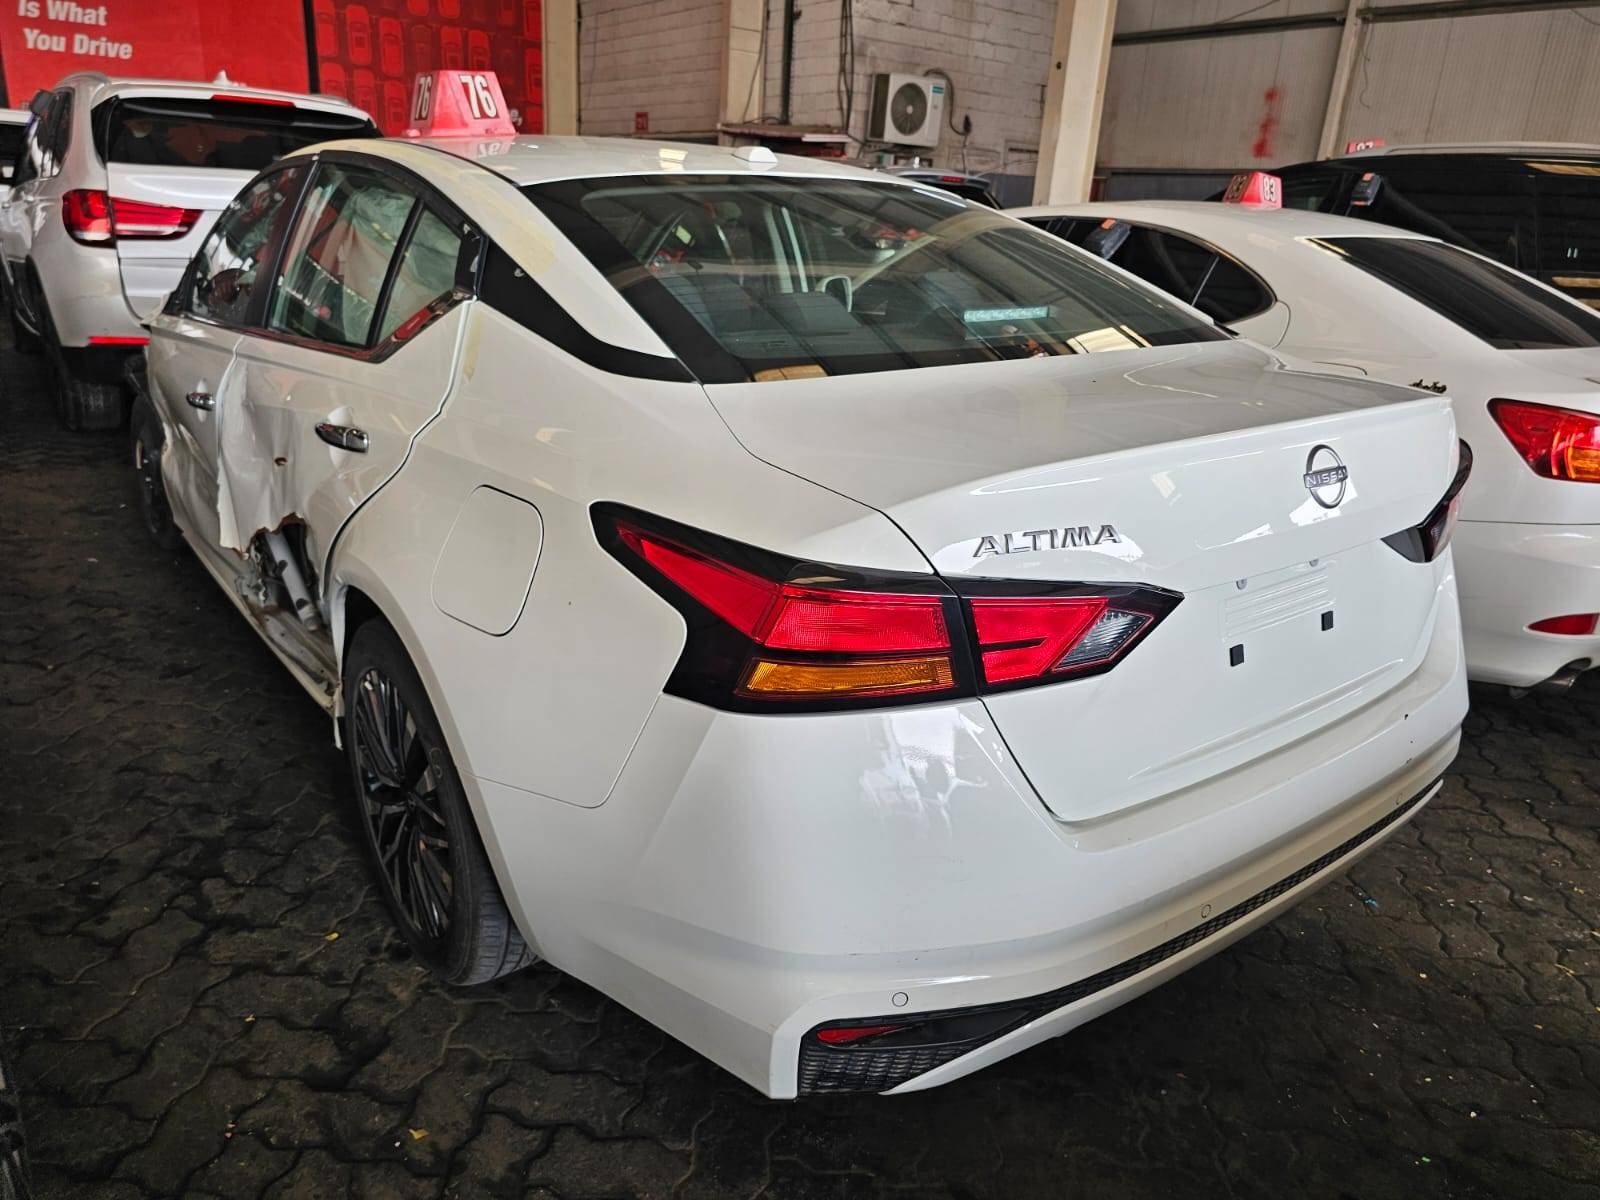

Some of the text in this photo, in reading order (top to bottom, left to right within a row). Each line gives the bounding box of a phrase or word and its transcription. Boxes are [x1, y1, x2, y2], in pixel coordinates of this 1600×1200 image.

[18, 0, 108, 26] Is What
[23, 28, 133, 59] You Drive
[415, 75, 432, 120] 76
[459, 75, 498, 119] 76
[1263, 176, 1277, 202] 83
[972, 525, 1122, 557] ALTIMA
